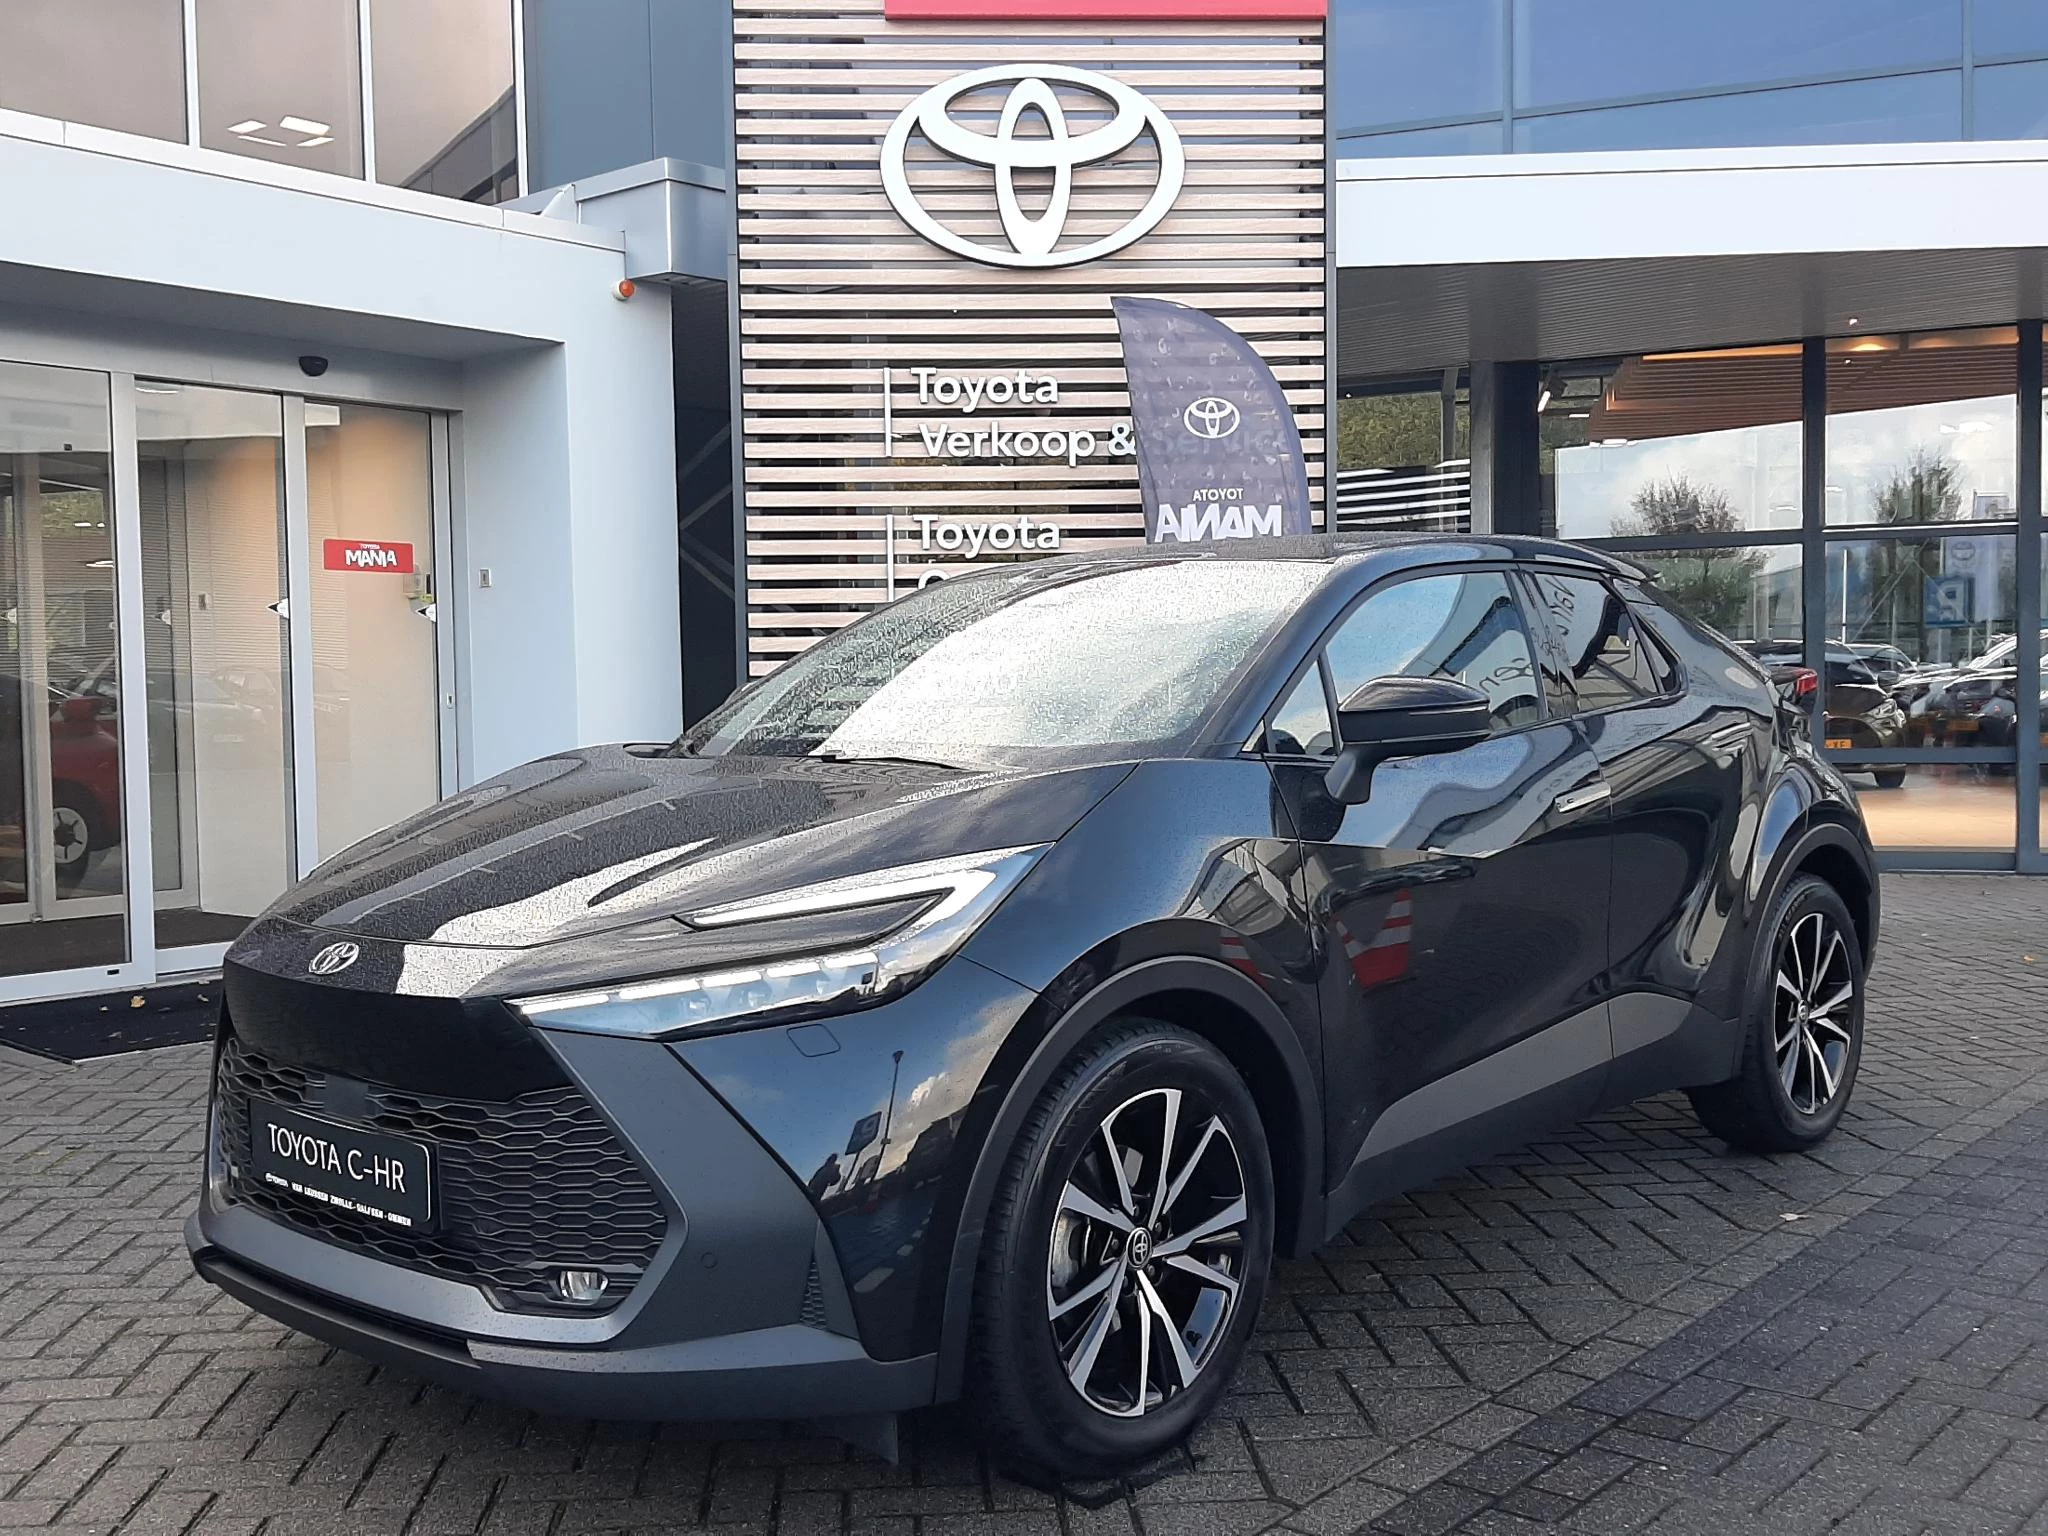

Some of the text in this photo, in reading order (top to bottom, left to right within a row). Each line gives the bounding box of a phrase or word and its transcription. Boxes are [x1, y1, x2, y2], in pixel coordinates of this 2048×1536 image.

[910, 367, 1059, 413] Toyota
[918, 421, 1096, 468] Verkoop
[1107, 422, 1137, 457] &
[345, 549, 397, 568] MANIA
[912, 514, 1060, 559] Toyota
[267, 1123, 406, 1193] TOYOTA C-HR
